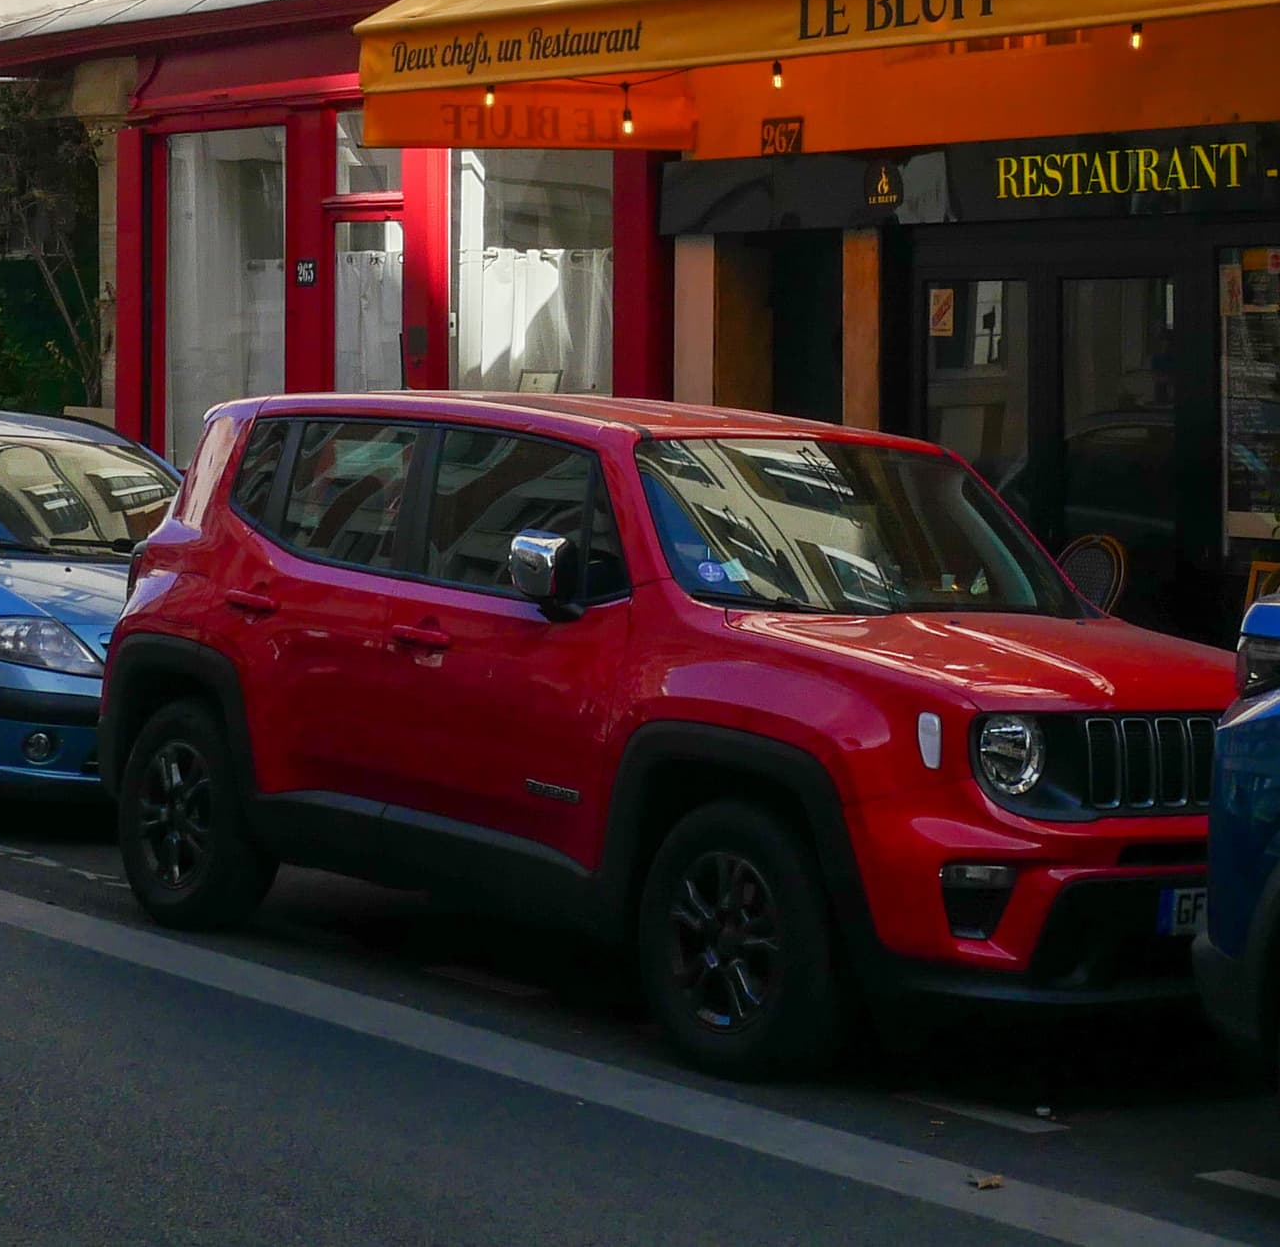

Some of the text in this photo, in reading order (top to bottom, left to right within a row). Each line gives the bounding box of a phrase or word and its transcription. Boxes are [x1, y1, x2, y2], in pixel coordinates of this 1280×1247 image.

[392, 20, 642, 74] Deux chefs, un Restaurant
[763, 122, 801, 154] 267
[996, 143, 1247, 199] RESTAURANT
[868, 194, 898, 205] LE BLUFF
[297, 262, 315, 283] 265
